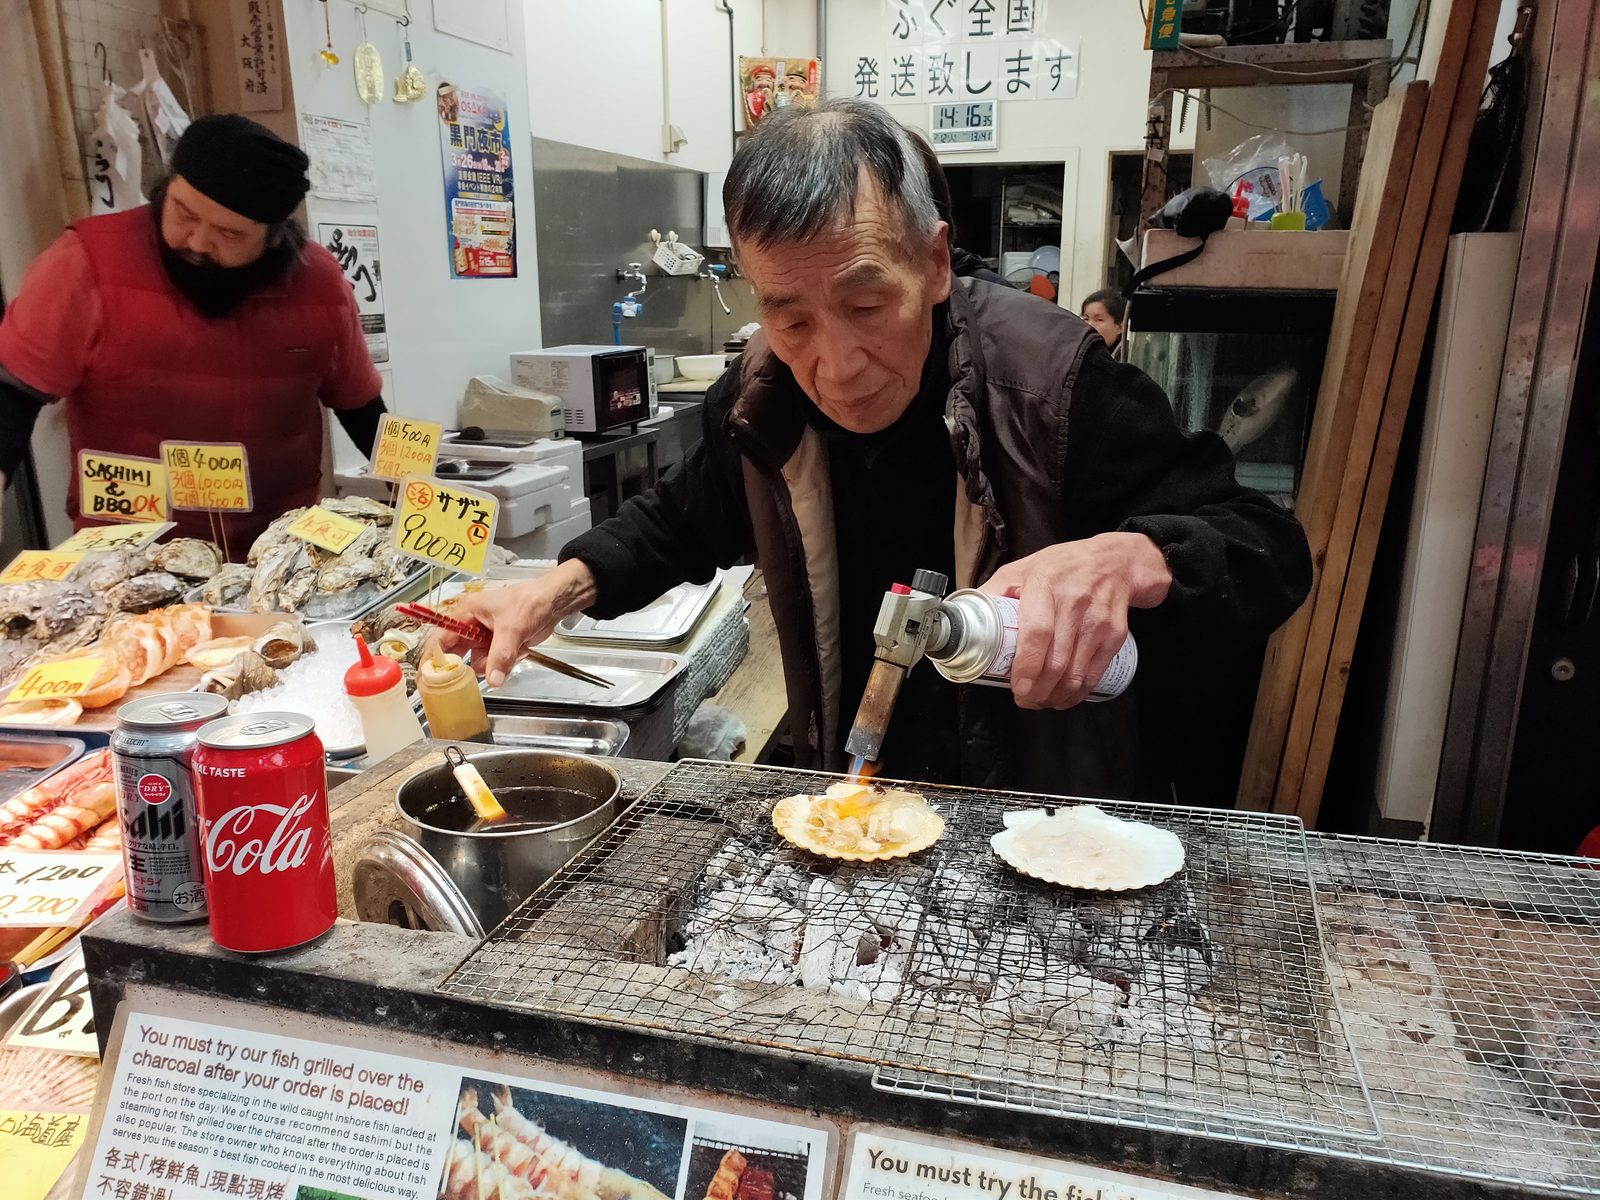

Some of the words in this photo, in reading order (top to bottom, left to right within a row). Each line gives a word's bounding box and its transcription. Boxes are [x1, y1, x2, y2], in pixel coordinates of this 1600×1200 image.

[854, 49, 1073, 97] 発送致します
[940, 104, 981, 128] 14:16
[450, 123, 502, 155] 黒門夜市
[384, 420, 400, 438] 1個
[402, 422, 431, 447] 500円
[84, 459, 151, 486] SASHIMI
[166, 448, 190, 468] 1個
[193, 448, 242, 472] 400円
[105, 482, 125, 497] &
[168, 470, 196, 490] 3個
[94, 495, 136, 515] BBQ
[132, 494, 165, 518] OK
[174, 490, 199, 507] 5個
[436, 491, 490, 528] サザエ
[400, 514, 466, 566] 900円
[6, 558, 77, 578] 生食可
[209, 766, 246, 778] TASTE
[130, 854, 148, 874] 生
[140, 1024, 169, 1046] You
[172, 1035, 212, 1054] must
[216, 1040, 238, 1061] try
[240, 1047, 268, 1064] our
[271, 1049, 299, 1070] fish
[303, 1058, 354, 1079] grilled
[358, 1069, 394, 1088] over
[397, 1073, 424, 1094] the
[132, 1050, 202, 1076] charcoal
[204, 1062, 241, 1082] after
[242, 1071, 280, 1090] your
[282, 1079, 327, 1102] order
[330, 1084, 344, 1102] is
[347, 1090, 410, 1116] placed!
[124, 1086, 139, 1098] the
[142, 1090, 162, 1102] port
[166, 1096, 178, 1104] on
[181, 1097, 196, 1108] the
[198, 1101, 218, 1113] day.
[222, 1104, 236, 1116] We
[239, 1108, 250, 1118] of
[252, 1114, 286, 1126] course
[288, 1119, 350, 1138] recommend
[352, 1132, 392, 1148] sashimi
[395, 1140, 412, 1152] but
[416, 1144, 432, 1156] the
[126, 1072, 152, 1086] Fresh
[154, 1077, 170, 1090] fish
[172, 1082, 196, 1094] store
[198, 1086, 250, 1106] specializing
[252, 1096, 260, 1106] in
[262, 1098, 277, 1110] the
[280, 1102, 299, 1114] wild
[300, 1106, 333, 1122] caught
[336, 1112, 370, 1128] inshore
[372, 1120, 390, 1132] fish
[392, 1124, 429, 1140] landed
[427, 1132, 437, 1142] at
[120, 1100, 160, 1117] steaming
[162, 1108, 178, 1119] hot
[180, 1111, 196, 1122] fish
[197, 1116, 225, 1128] grilled
[226, 1122, 246, 1132] over
[248, 1125, 262, 1136] the
[264, 1129, 305, 1144] charcoal
[307, 1137, 330, 1150] after
[332, 1141, 347, 1153] the
[349, 1147, 374, 1159] order
[376, 1150, 384, 1160] is
[386, 1154, 420, 1168] placed
[422, 1160, 430, 1170] is
[112, 1128, 142, 1140] serves
[143, 1134, 160, 1144] you
[162, 1137, 176, 1148] the
[220, 1150, 240, 1162] best
[242, 1154, 259, 1166] fish
[261, 1159, 296, 1172] cooked
[298, 1166, 306, 1174] in
[309, 1168, 324, 1178] the
[326, 1174, 350, 1184] most
[352, 1177, 395, 1194] delicious
[398, 1186, 418, 1200] way.
[116, 1114, 136, 1125] also
[138, 1120, 177, 1134] popular.
[182, 1125, 198, 1138] The
[200, 1131, 224, 1143] store
[226, 1137, 258, 1150] owner
[260, 1143, 280, 1154] who
[282, 1146, 315, 1162] knows
[318, 1155, 372, 1176] everything
[374, 1166, 404, 1180] about
[407, 1172, 426, 1186] fish
[868, 1149, 908, 1174] You
[916, 1163, 972, 1186] must
[978, 1170, 1013, 1200] try
[1018, 1177, 1058, 1200] the
[863, 1182, 895, 1198] Fresh
